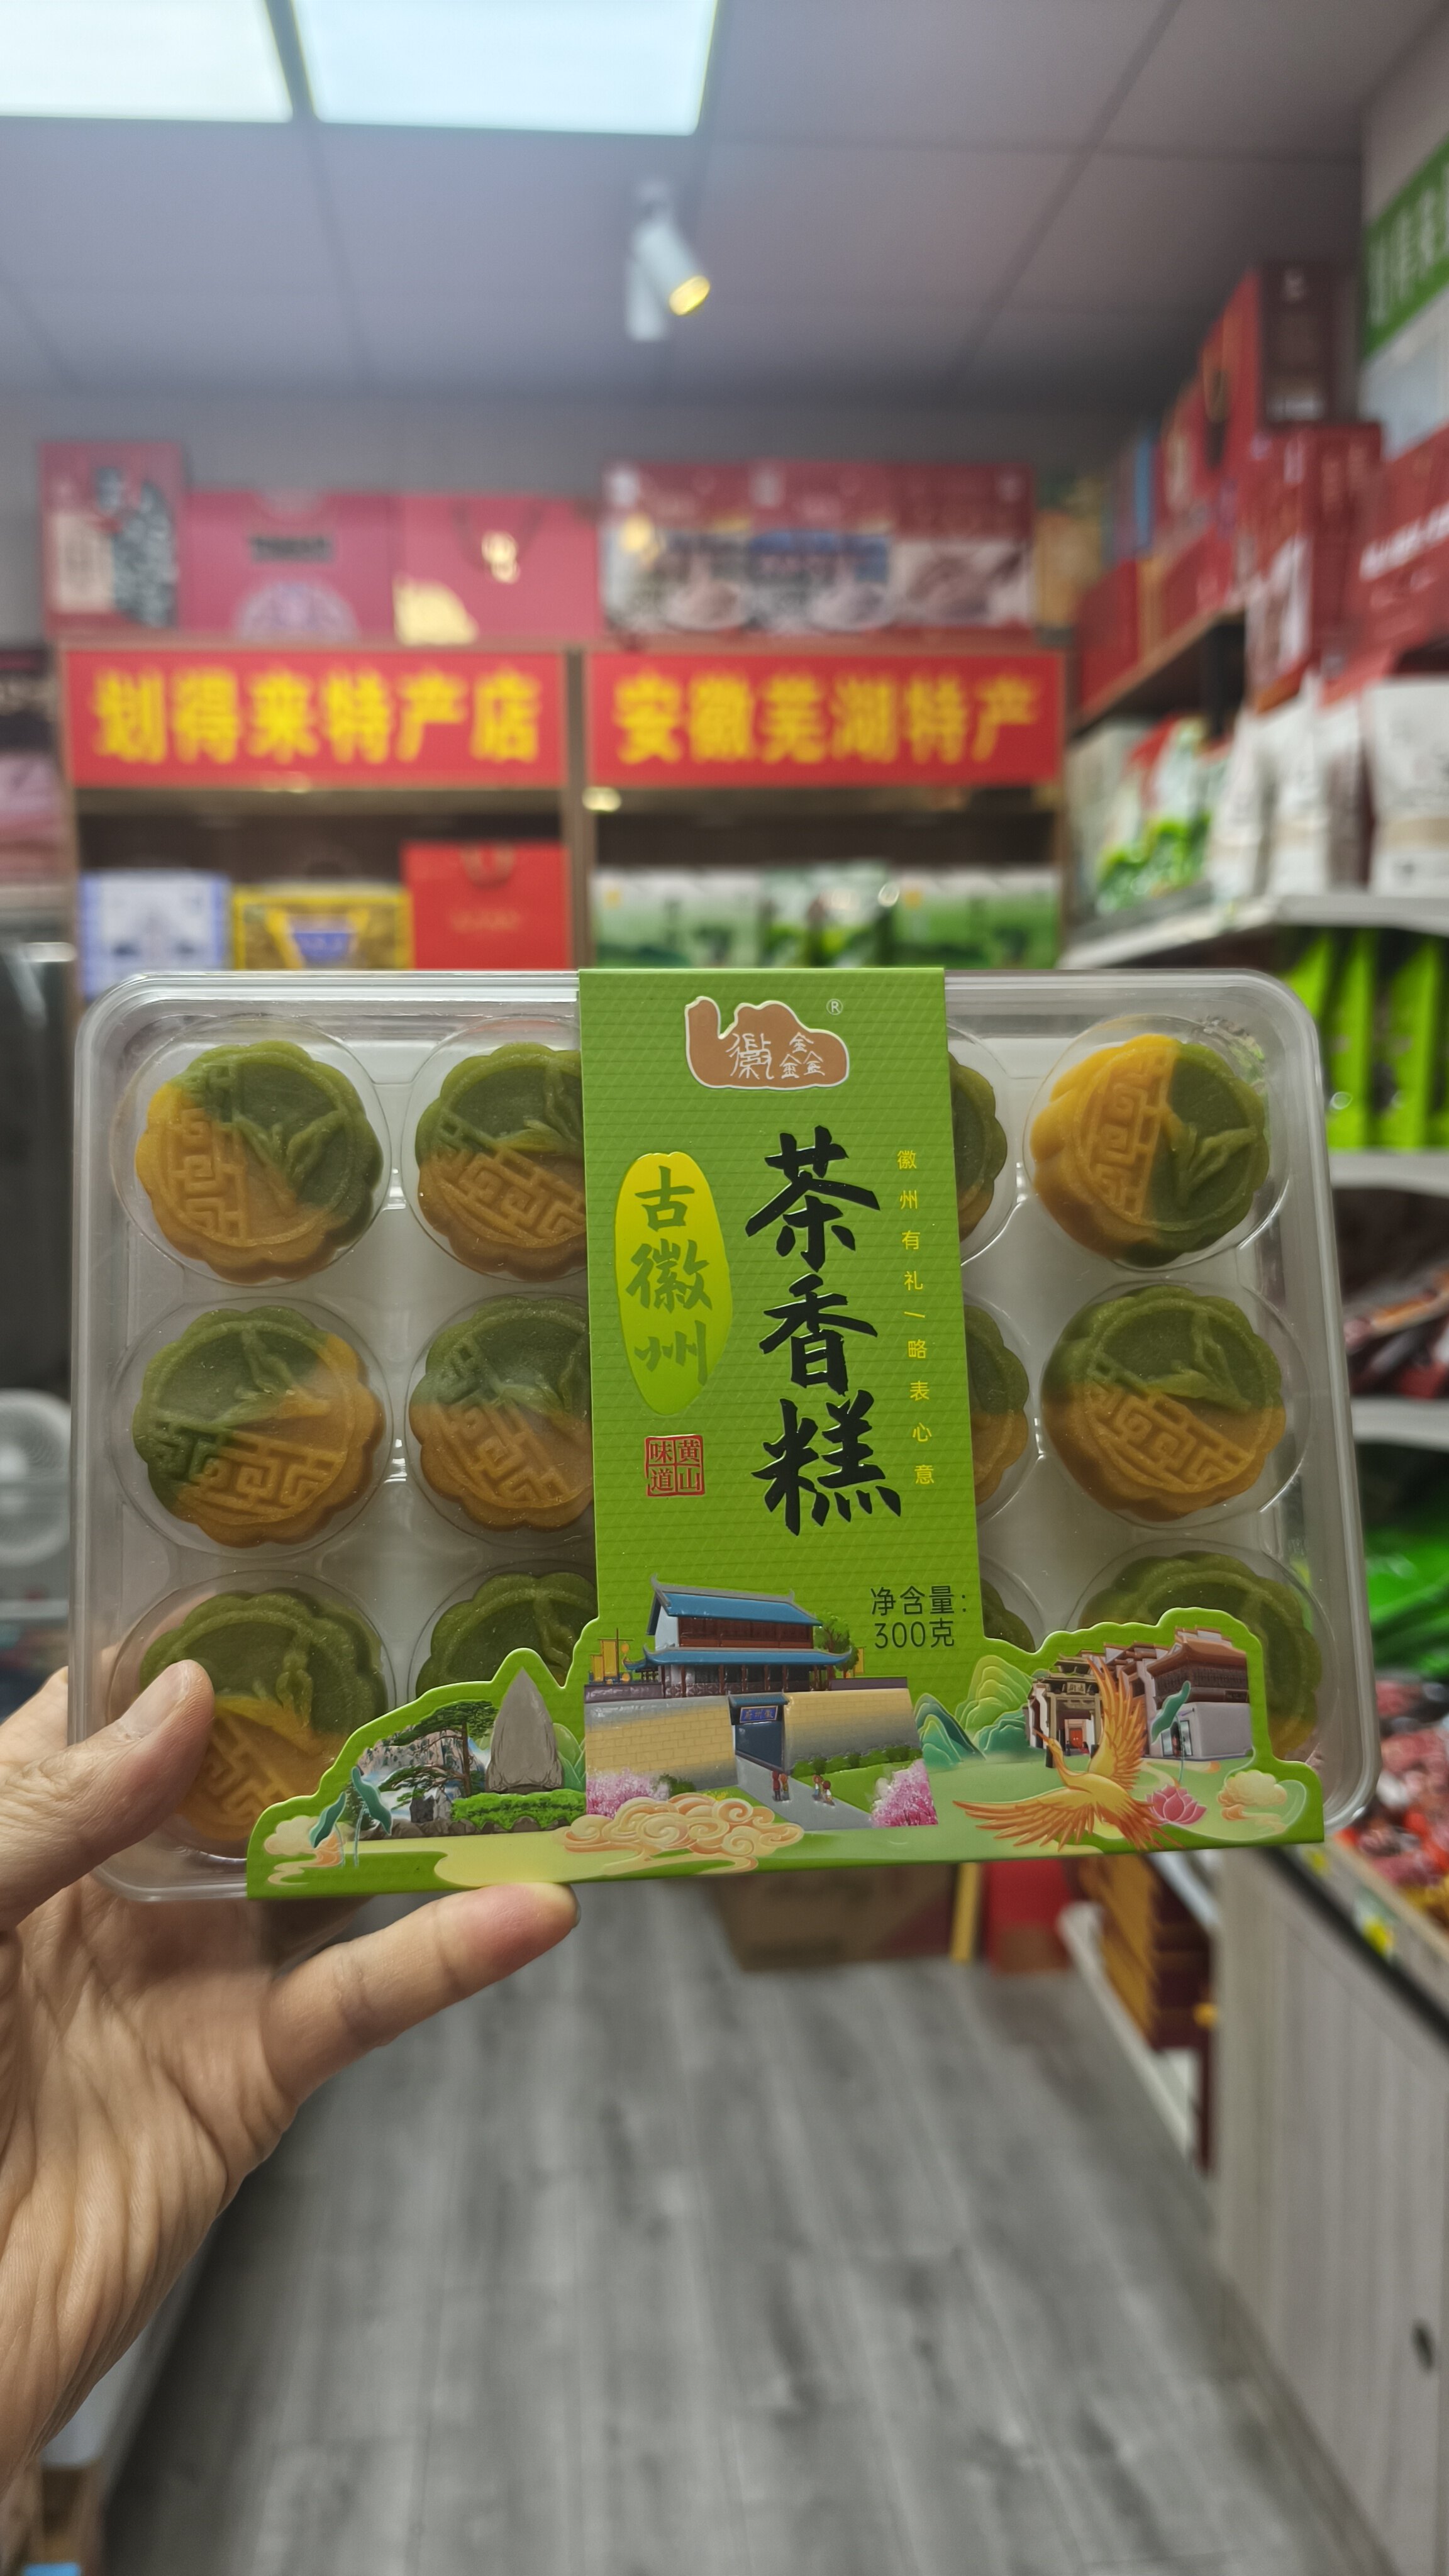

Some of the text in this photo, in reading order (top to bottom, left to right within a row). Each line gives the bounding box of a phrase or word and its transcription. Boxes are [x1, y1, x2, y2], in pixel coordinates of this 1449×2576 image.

[93, 667, 541, 763] 划得来特产店
[612, 669, 1039, 763] 安徽芜湖特产
[625, 1165, 713, 1386] 古徽州
[745, 1125, 901, 1536] 茶香糕
[870, 1585, 967, 1616] 净含量：
[874, 1618, 955, 1648] 300克
